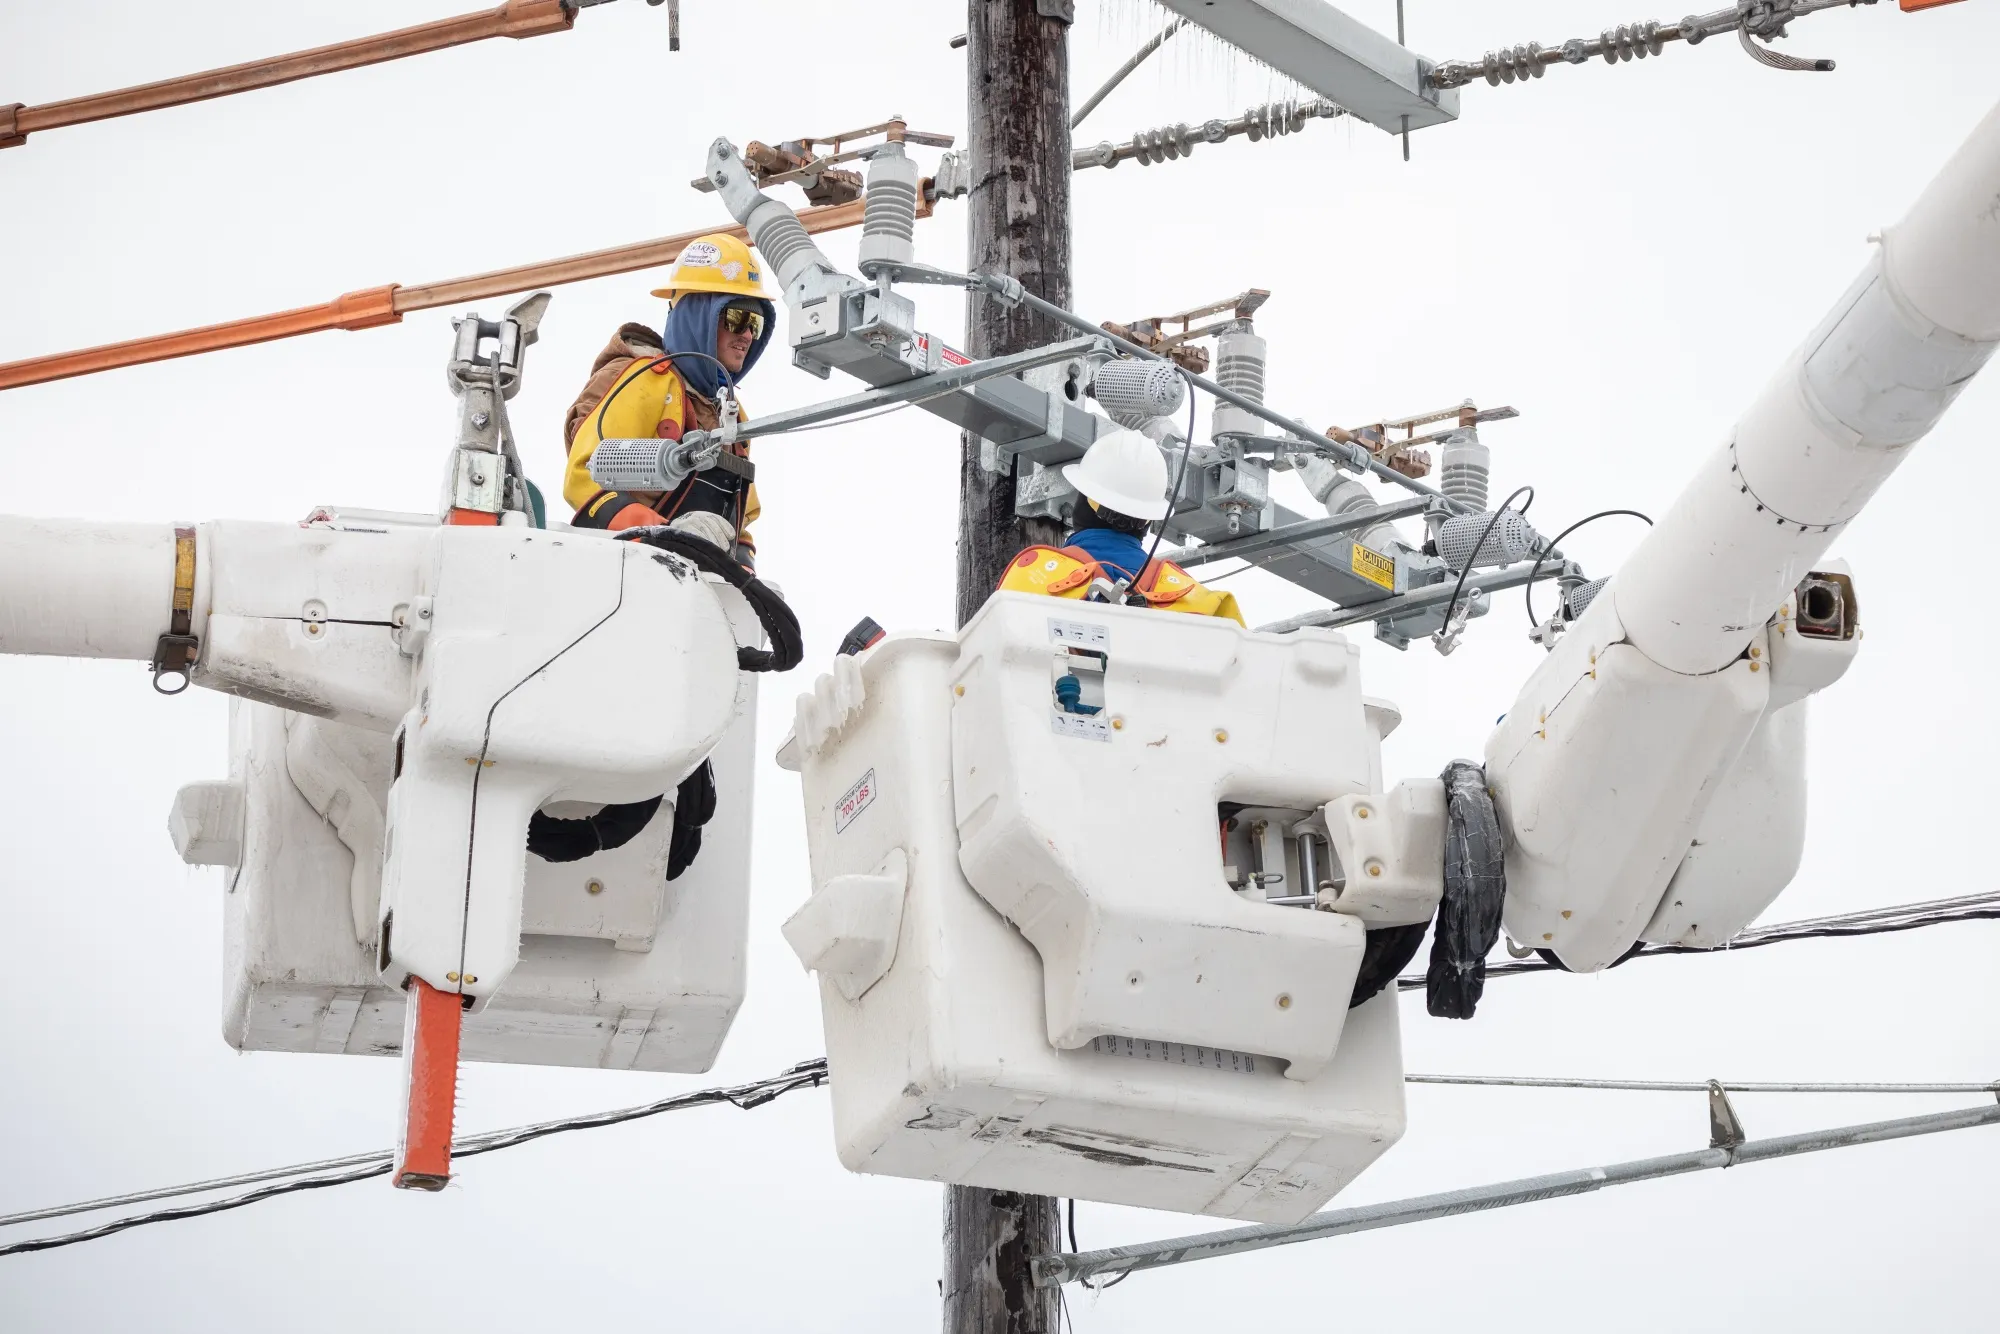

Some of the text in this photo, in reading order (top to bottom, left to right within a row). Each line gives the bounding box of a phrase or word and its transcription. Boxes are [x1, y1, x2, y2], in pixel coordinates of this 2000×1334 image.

[942, 350, 962, 366] ANGER
[1364, 551, 1394, 574] CAUTION
[842, 800, 855, 819] 700
[856, 785, 869, 805] LBS
